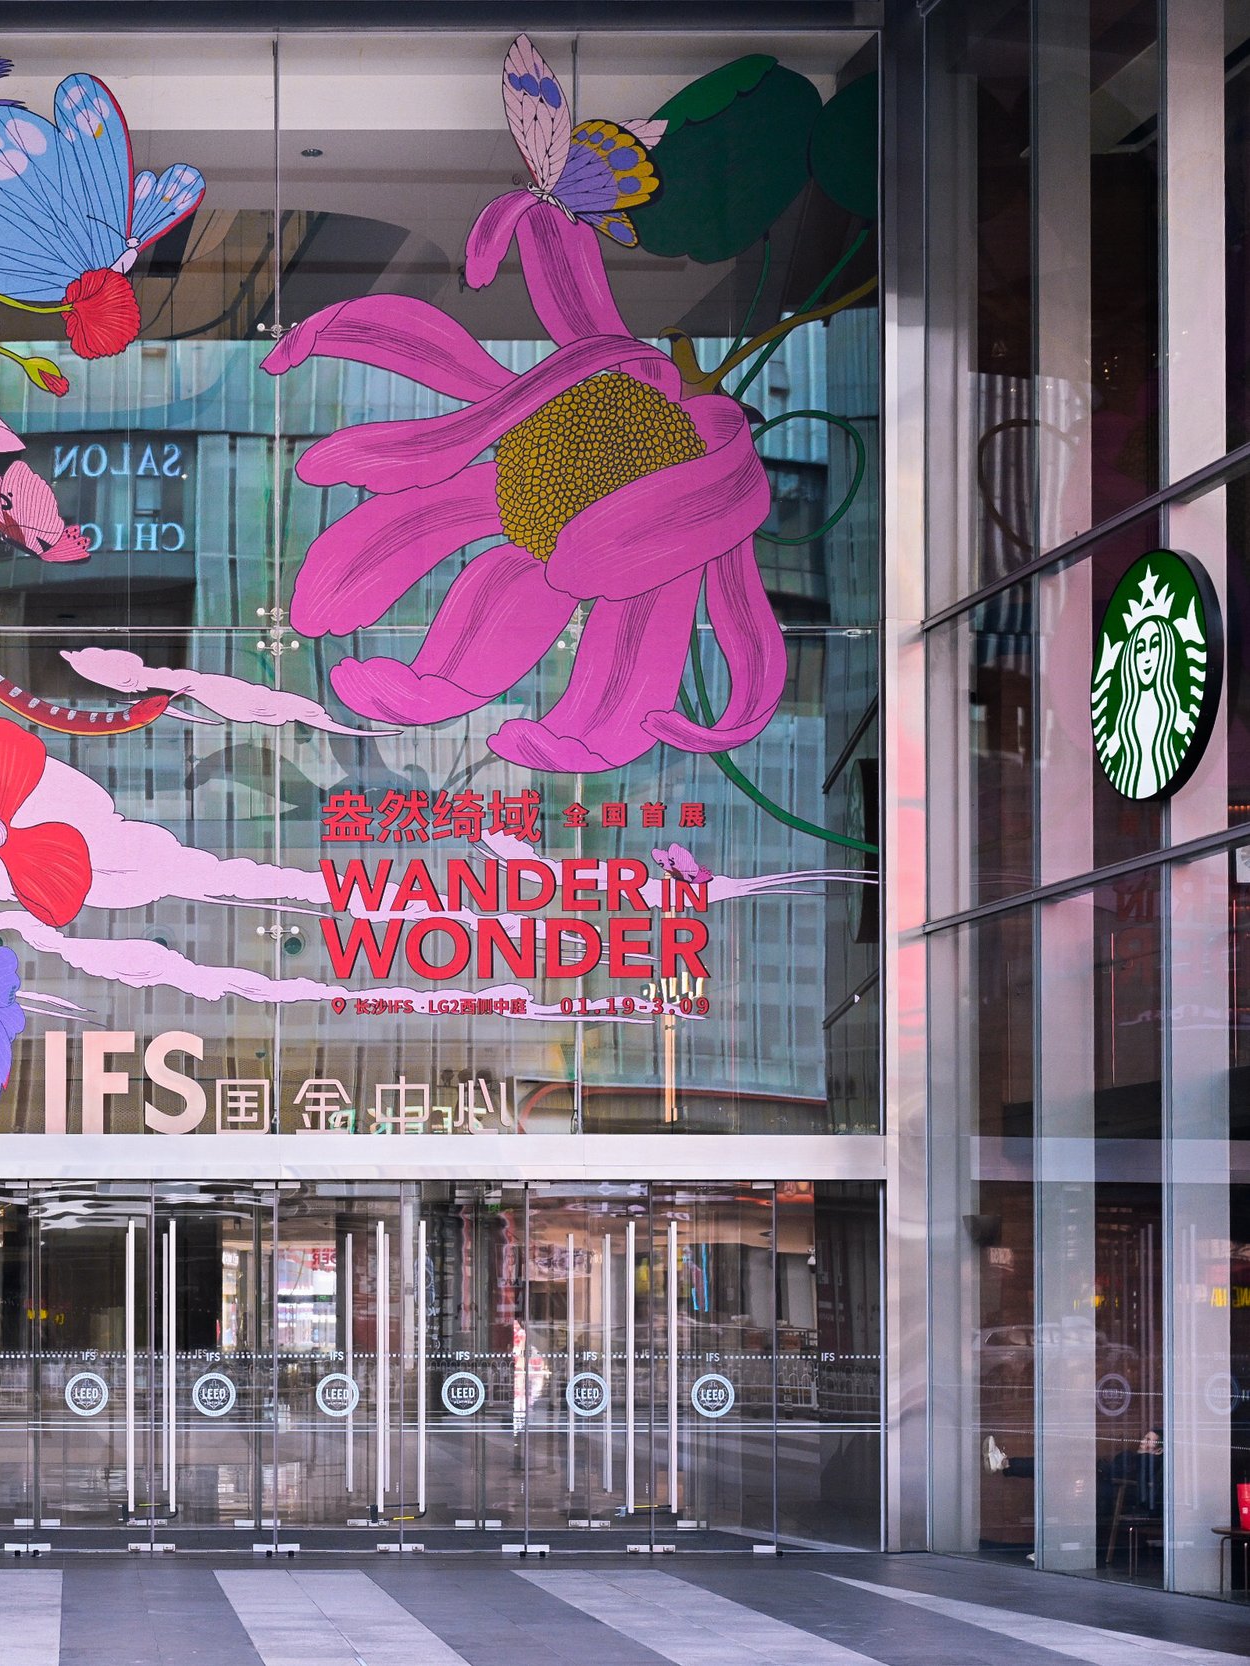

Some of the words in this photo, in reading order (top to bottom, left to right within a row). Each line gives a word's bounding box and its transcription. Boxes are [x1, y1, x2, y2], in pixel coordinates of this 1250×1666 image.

[320, 789, 542, 843] 盎然绮域
[562, 801, 707, 829] 全国首展
[318, 858, 650, 912] WANDER
[662, 878, 709, 913] IN
[318, 917, 711, 980] WONDER
[560, 997, 710, 1016] 01.19-3.09
[45, 1030, 207, 1134] IFS
[216, 1076, 512, 1134] 国金中心
[81, 1352, 96, 1360] IFS
[206, 1352, 221, 1361] IFS
[330, 1351, 344, 1361] IFS
[456, 1351, 470, 1360] IFS
[583, 1351, 598, 1361] IFS
[706, 1353, 720, 1362] IFS
[821, 1353, 835, 1362] IFS
[74, 1387, 99, 1399] LEED
[202, 1388, 226, 1400] LEED
[325, 1388, 349, 1400] LEED
[451, 1387, 475, 1399] LEED
[576, 1387, 599, 1399] LEED
[701, 1389, 725, 1400] LEED
